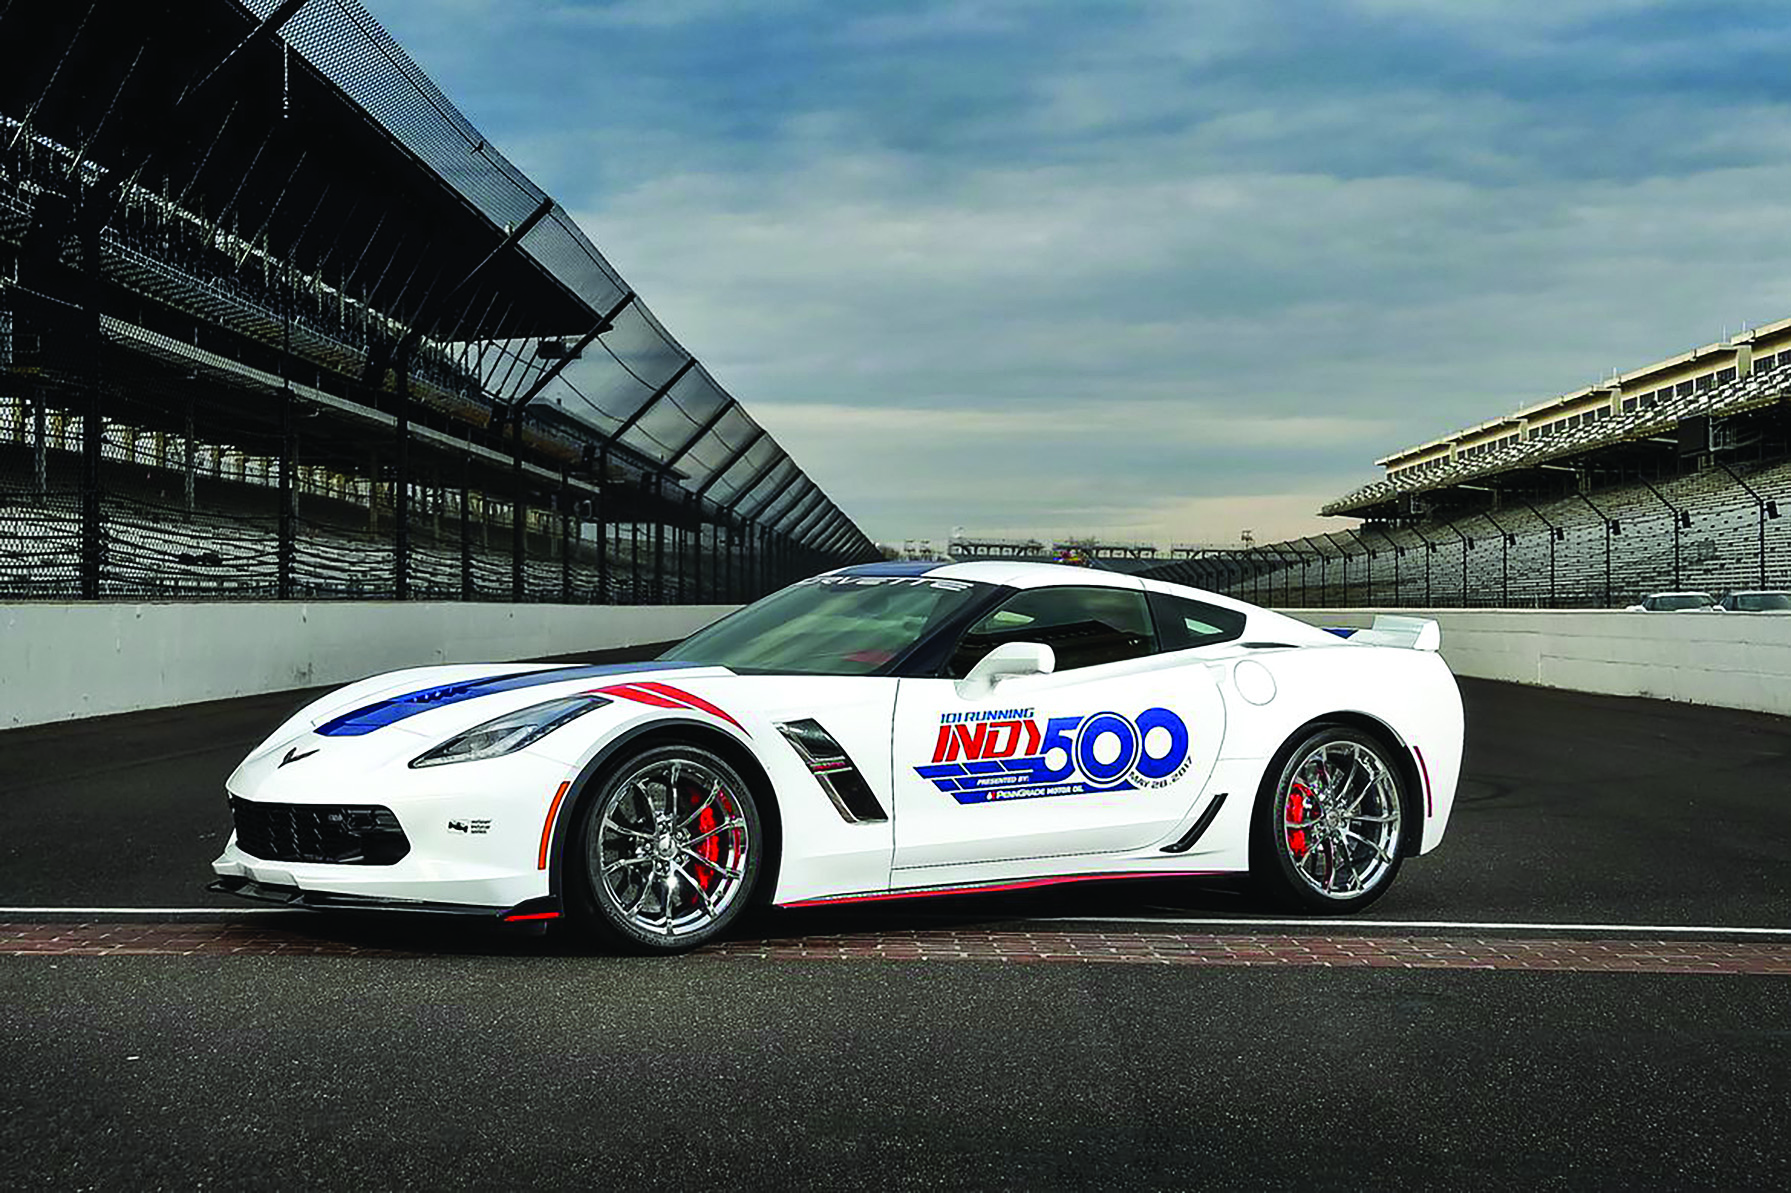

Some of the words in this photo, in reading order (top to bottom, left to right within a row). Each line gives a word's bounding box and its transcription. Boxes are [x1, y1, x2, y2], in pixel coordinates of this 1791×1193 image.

[941, 712, 962, 724] 101
[964, 707, 1035, 722] RUNNING
[931, 719, 1041, 763] INDY
[1039, 707, 1189, 784] 500
[1129, 771, 1151, 788] MAY
